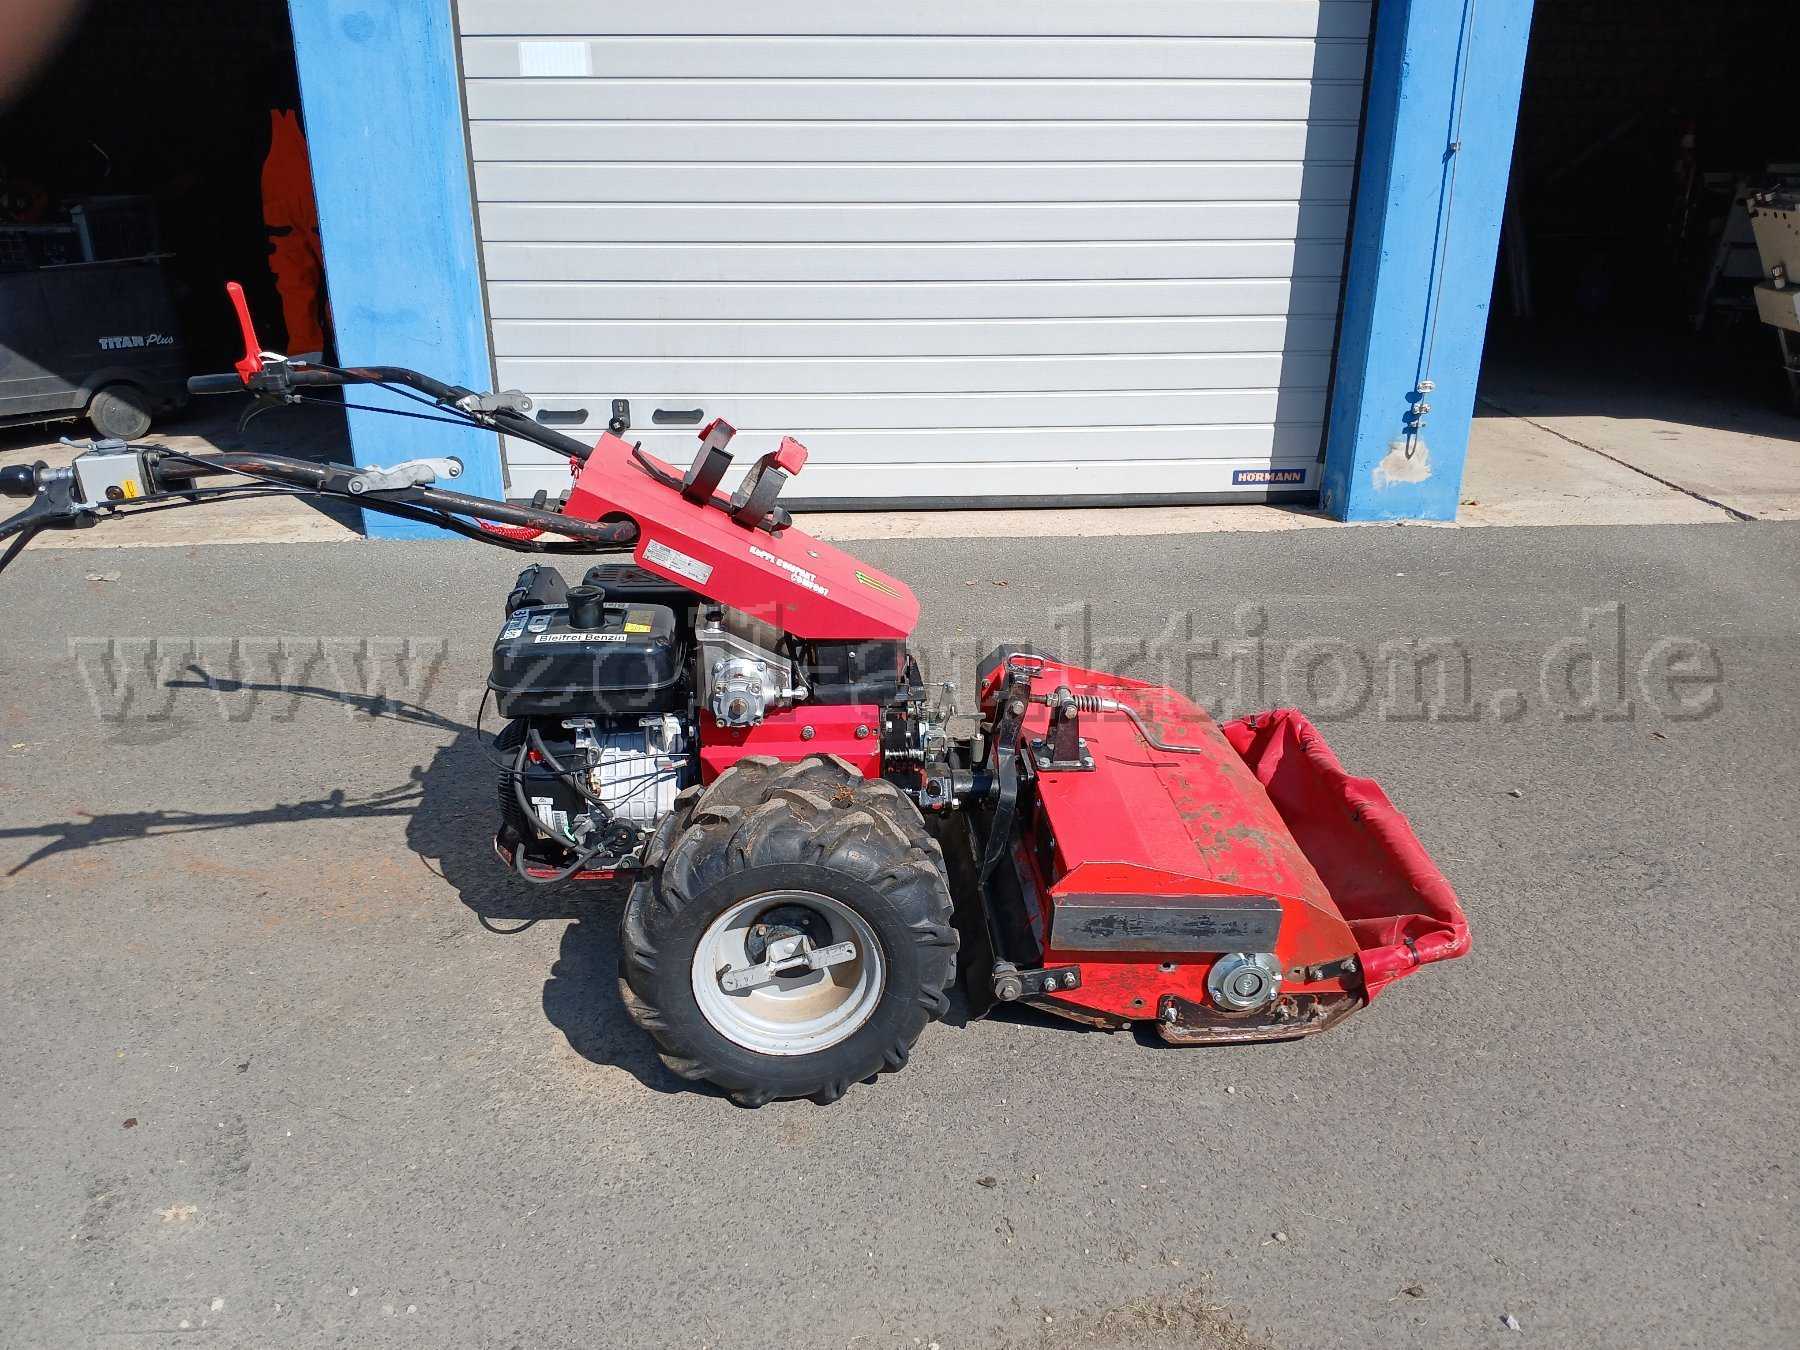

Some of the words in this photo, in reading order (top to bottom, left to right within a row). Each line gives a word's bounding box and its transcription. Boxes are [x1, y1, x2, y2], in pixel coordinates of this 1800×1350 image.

[99, 336, 144, 350] TITAN
[146, 334, 174, 346] Plus
[1238, 472, 1301, 482] HÖRMANN
[540, 634, 581, 642] Bleifrei
[585, 633, 625, 641] Benzin
